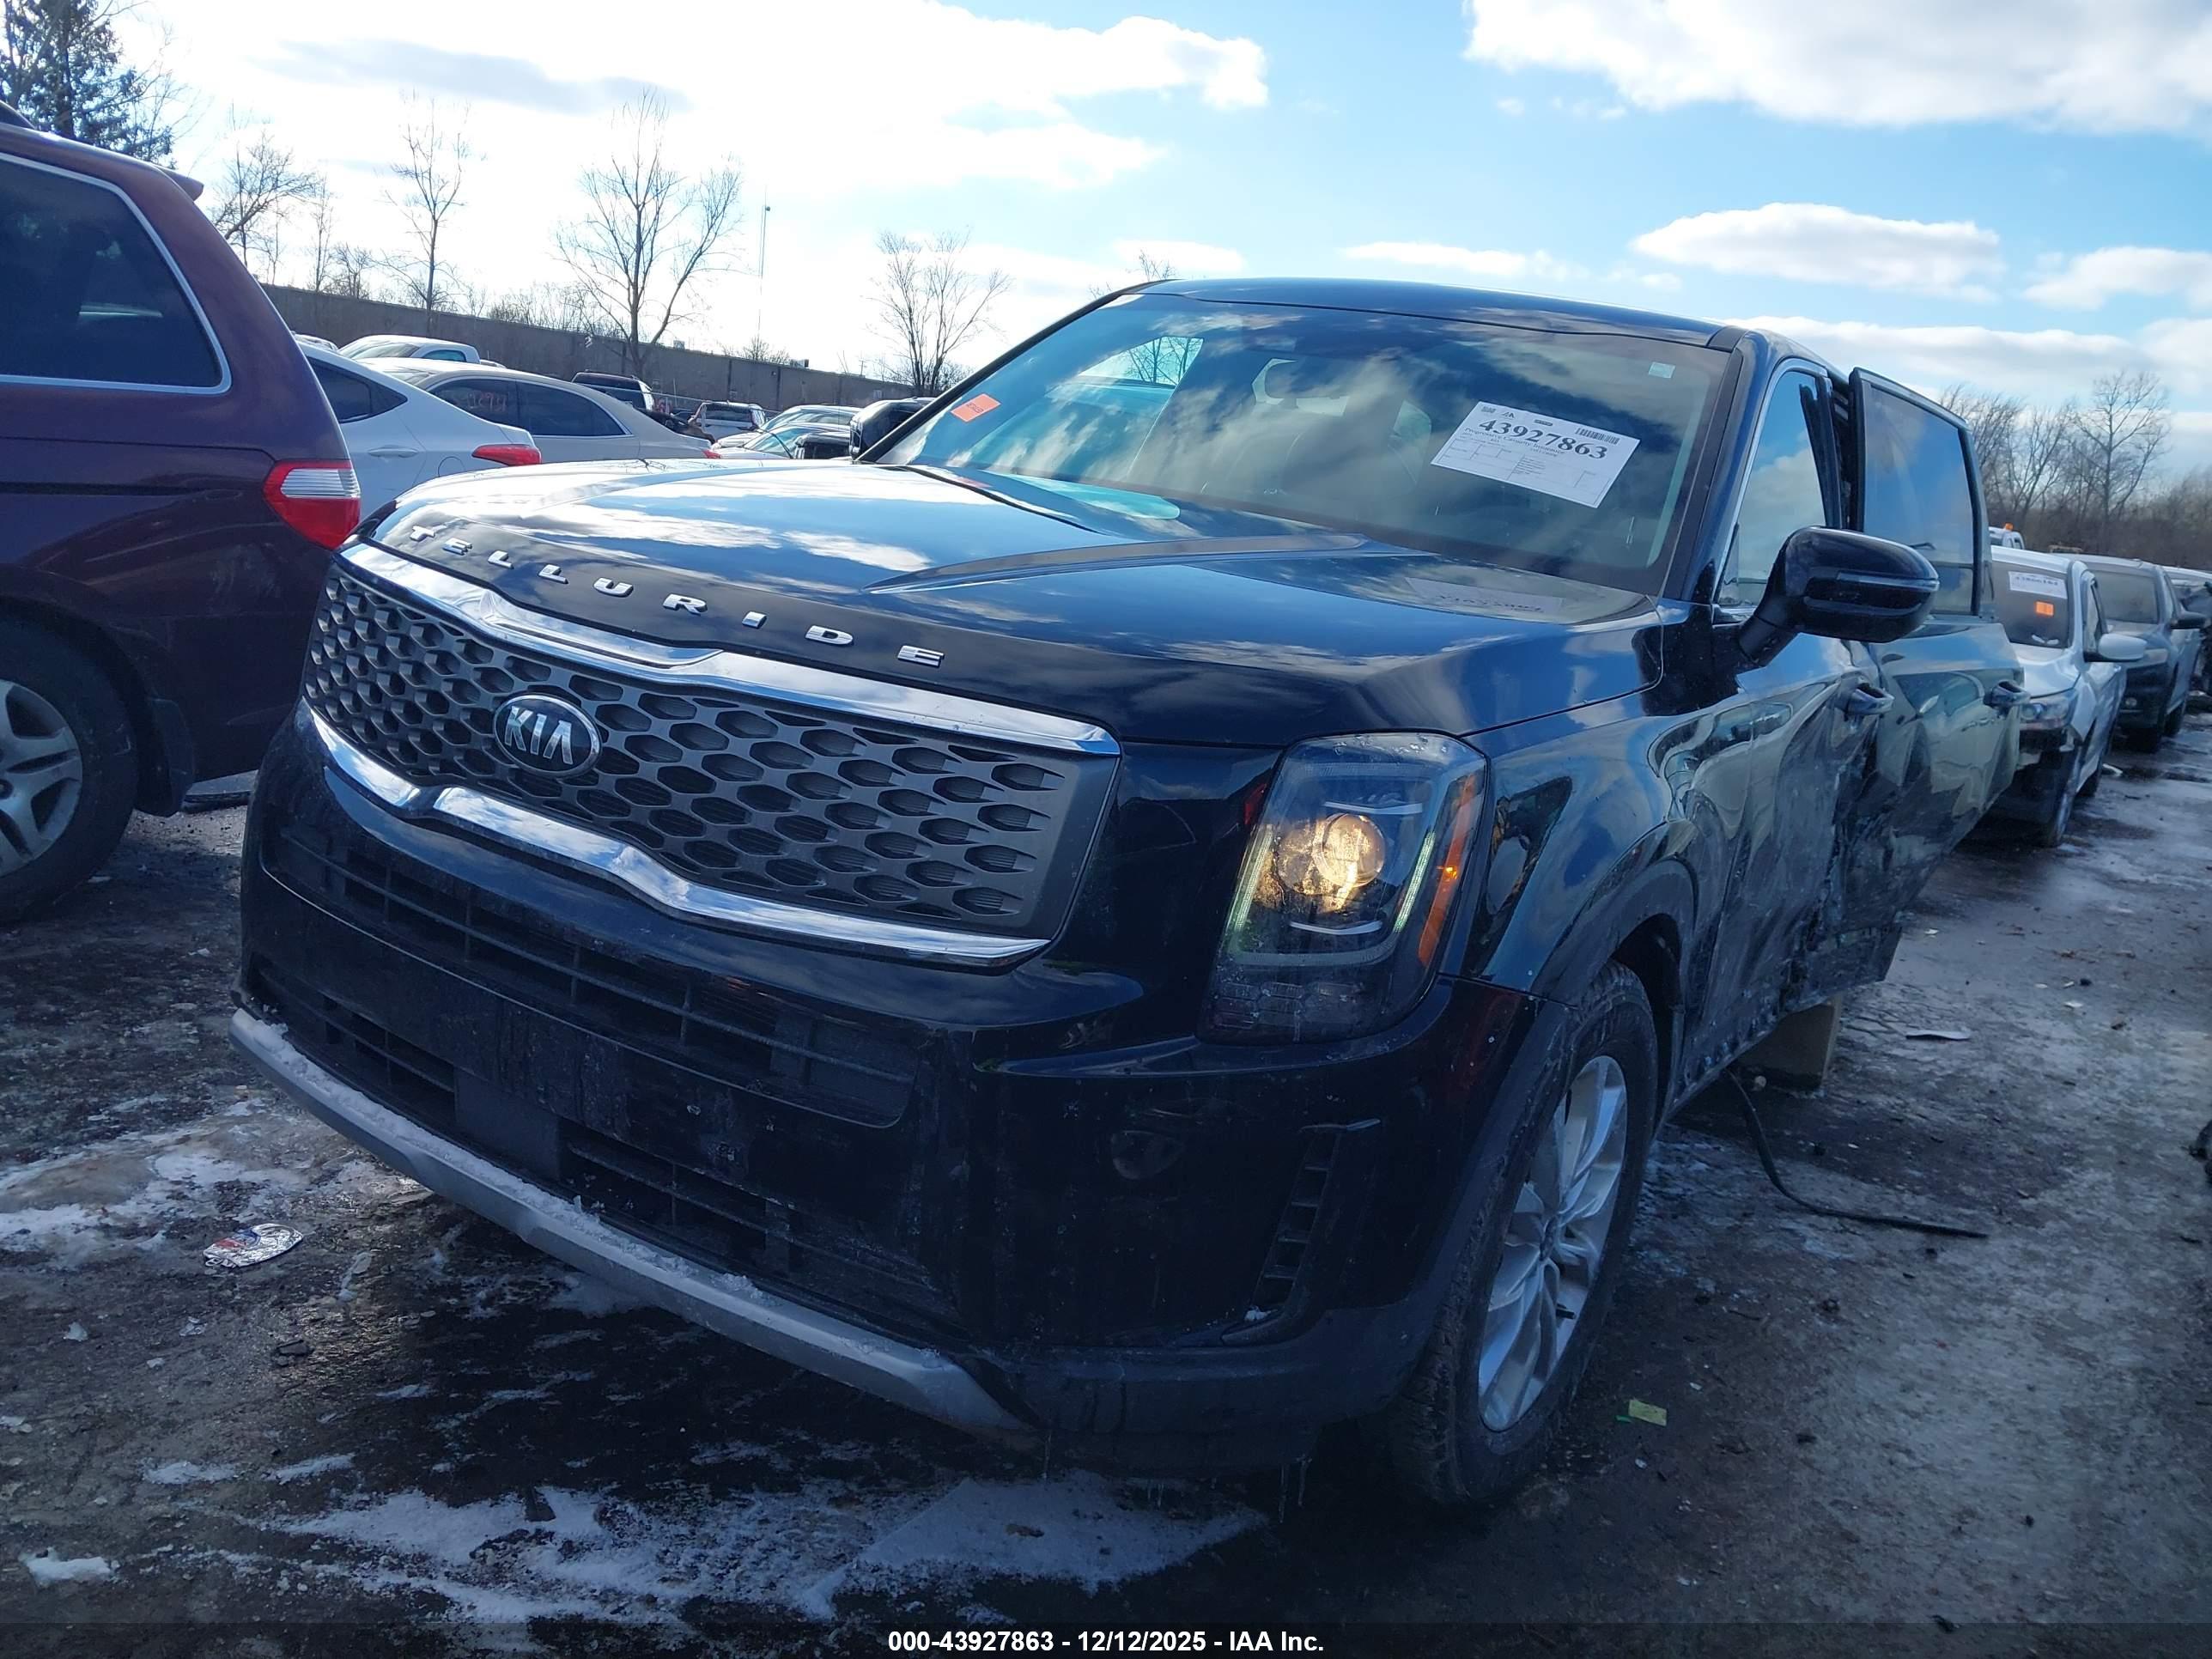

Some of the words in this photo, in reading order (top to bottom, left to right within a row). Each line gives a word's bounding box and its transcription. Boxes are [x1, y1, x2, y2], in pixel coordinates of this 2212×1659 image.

[1479, 419, 1608, 459] 43927863
[410, 524, 945, 666] TELLURIDE
[504, 706, 573, 764] KIA
